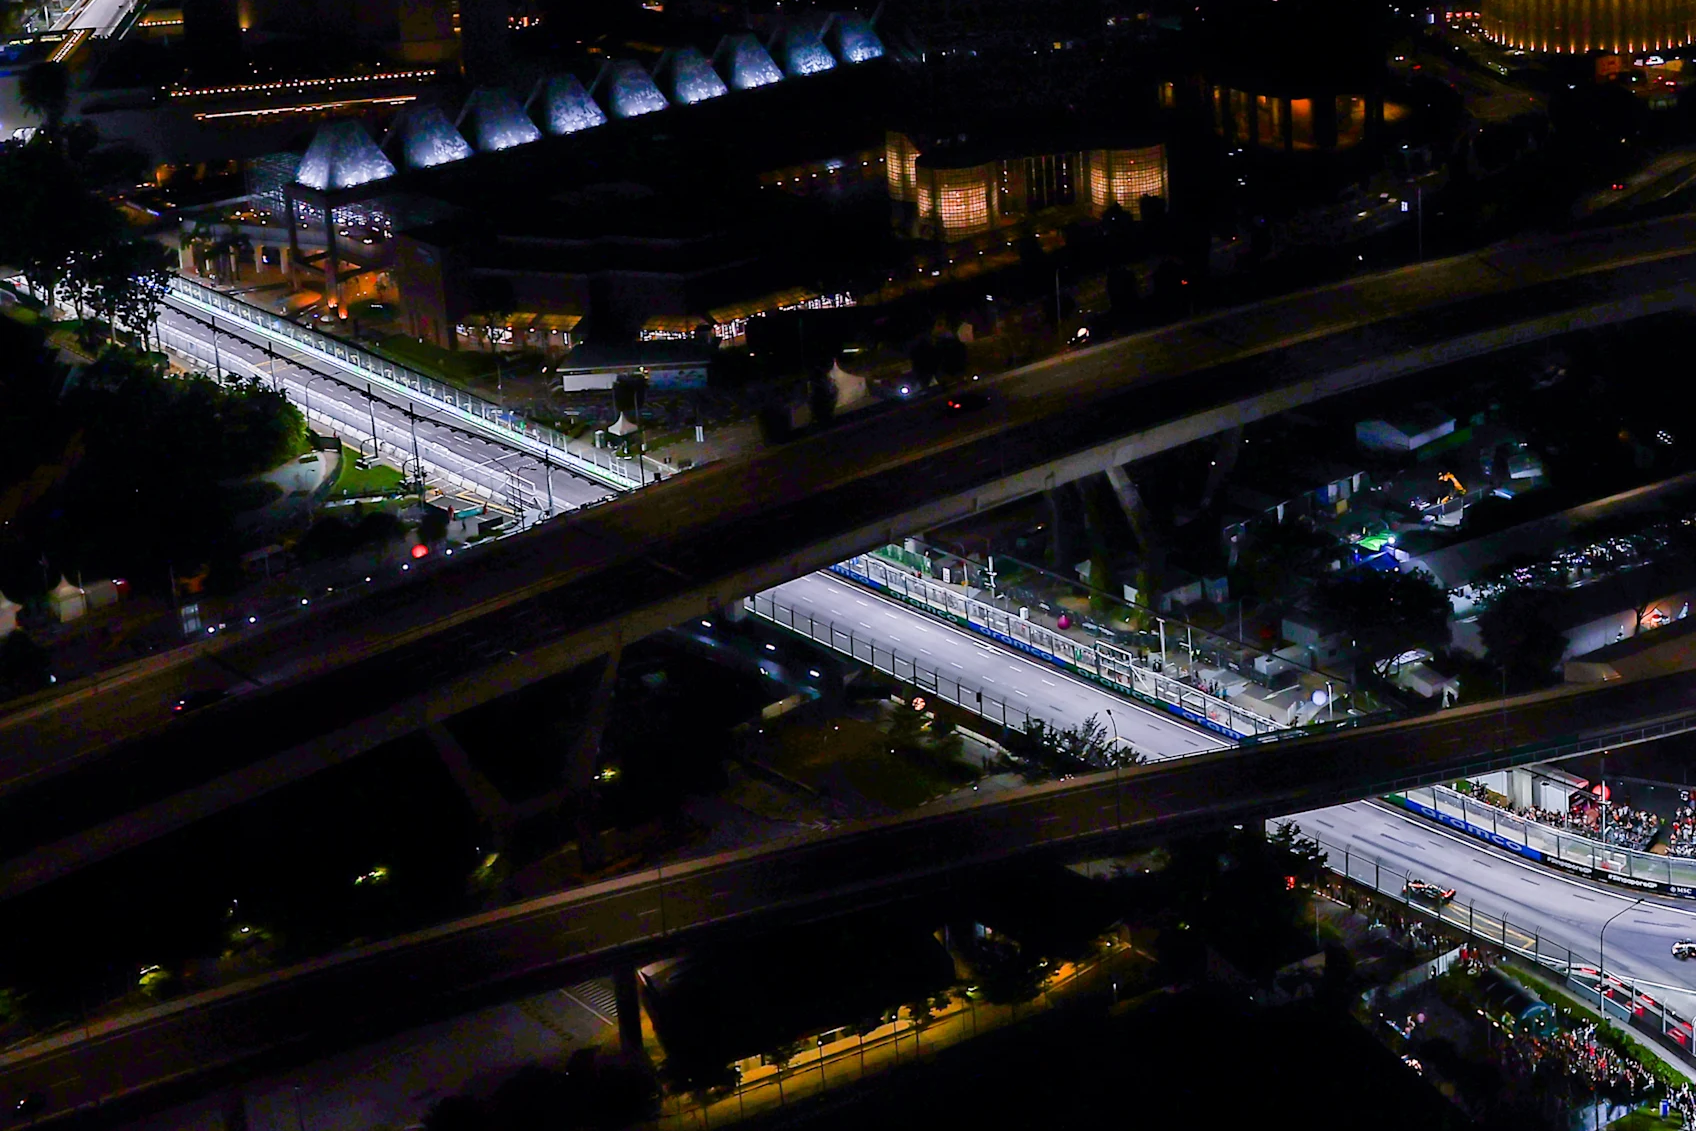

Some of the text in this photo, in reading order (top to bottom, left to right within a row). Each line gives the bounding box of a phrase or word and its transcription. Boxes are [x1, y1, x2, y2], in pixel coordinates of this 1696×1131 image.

[412, 391, 456, 414] aramco
[469, 415, 515, 438] aramco
[889, 590, 957, 623] aramco
[980, 627, 1053, 661] aramco
[1077, 668, 1156, 705] aramco
[1420, 807, 1523, 851] aramco
[1676, 886, 1692, 895] MSC
